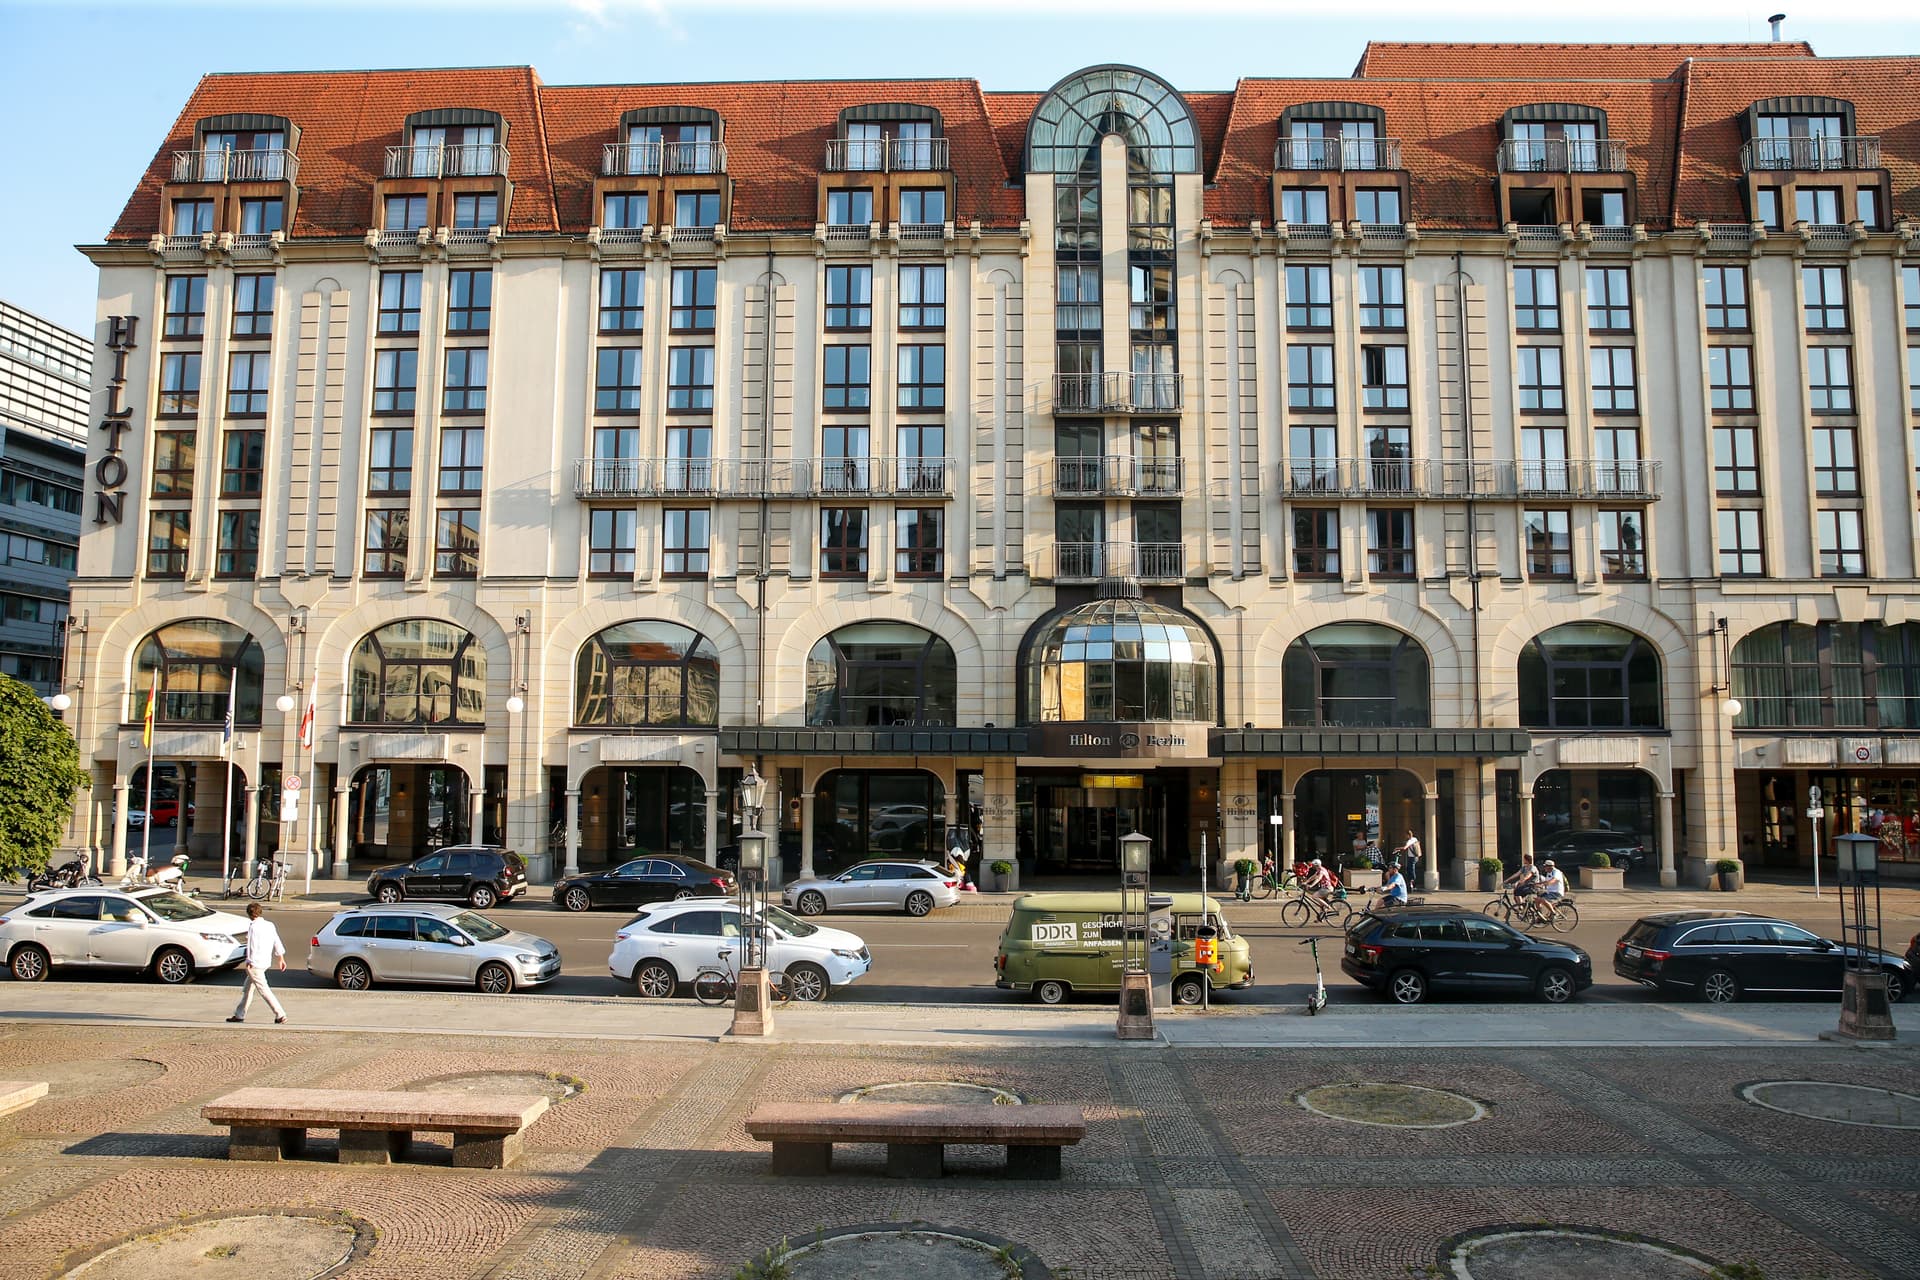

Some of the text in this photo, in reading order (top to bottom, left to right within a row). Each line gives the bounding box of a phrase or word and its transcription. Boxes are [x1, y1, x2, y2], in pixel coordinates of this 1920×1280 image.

[93, 315, 139, 525] HILTON
[1069, 733, 1187, 746] Hilton Berlin
[1082, 920, 1125, 929] GESCHICHT
[1036, 925, 1073, 940] DDR
[1082, 931, 1100, 939] ZUM
[1083, 940, 1122, 948] ANFASSEN
